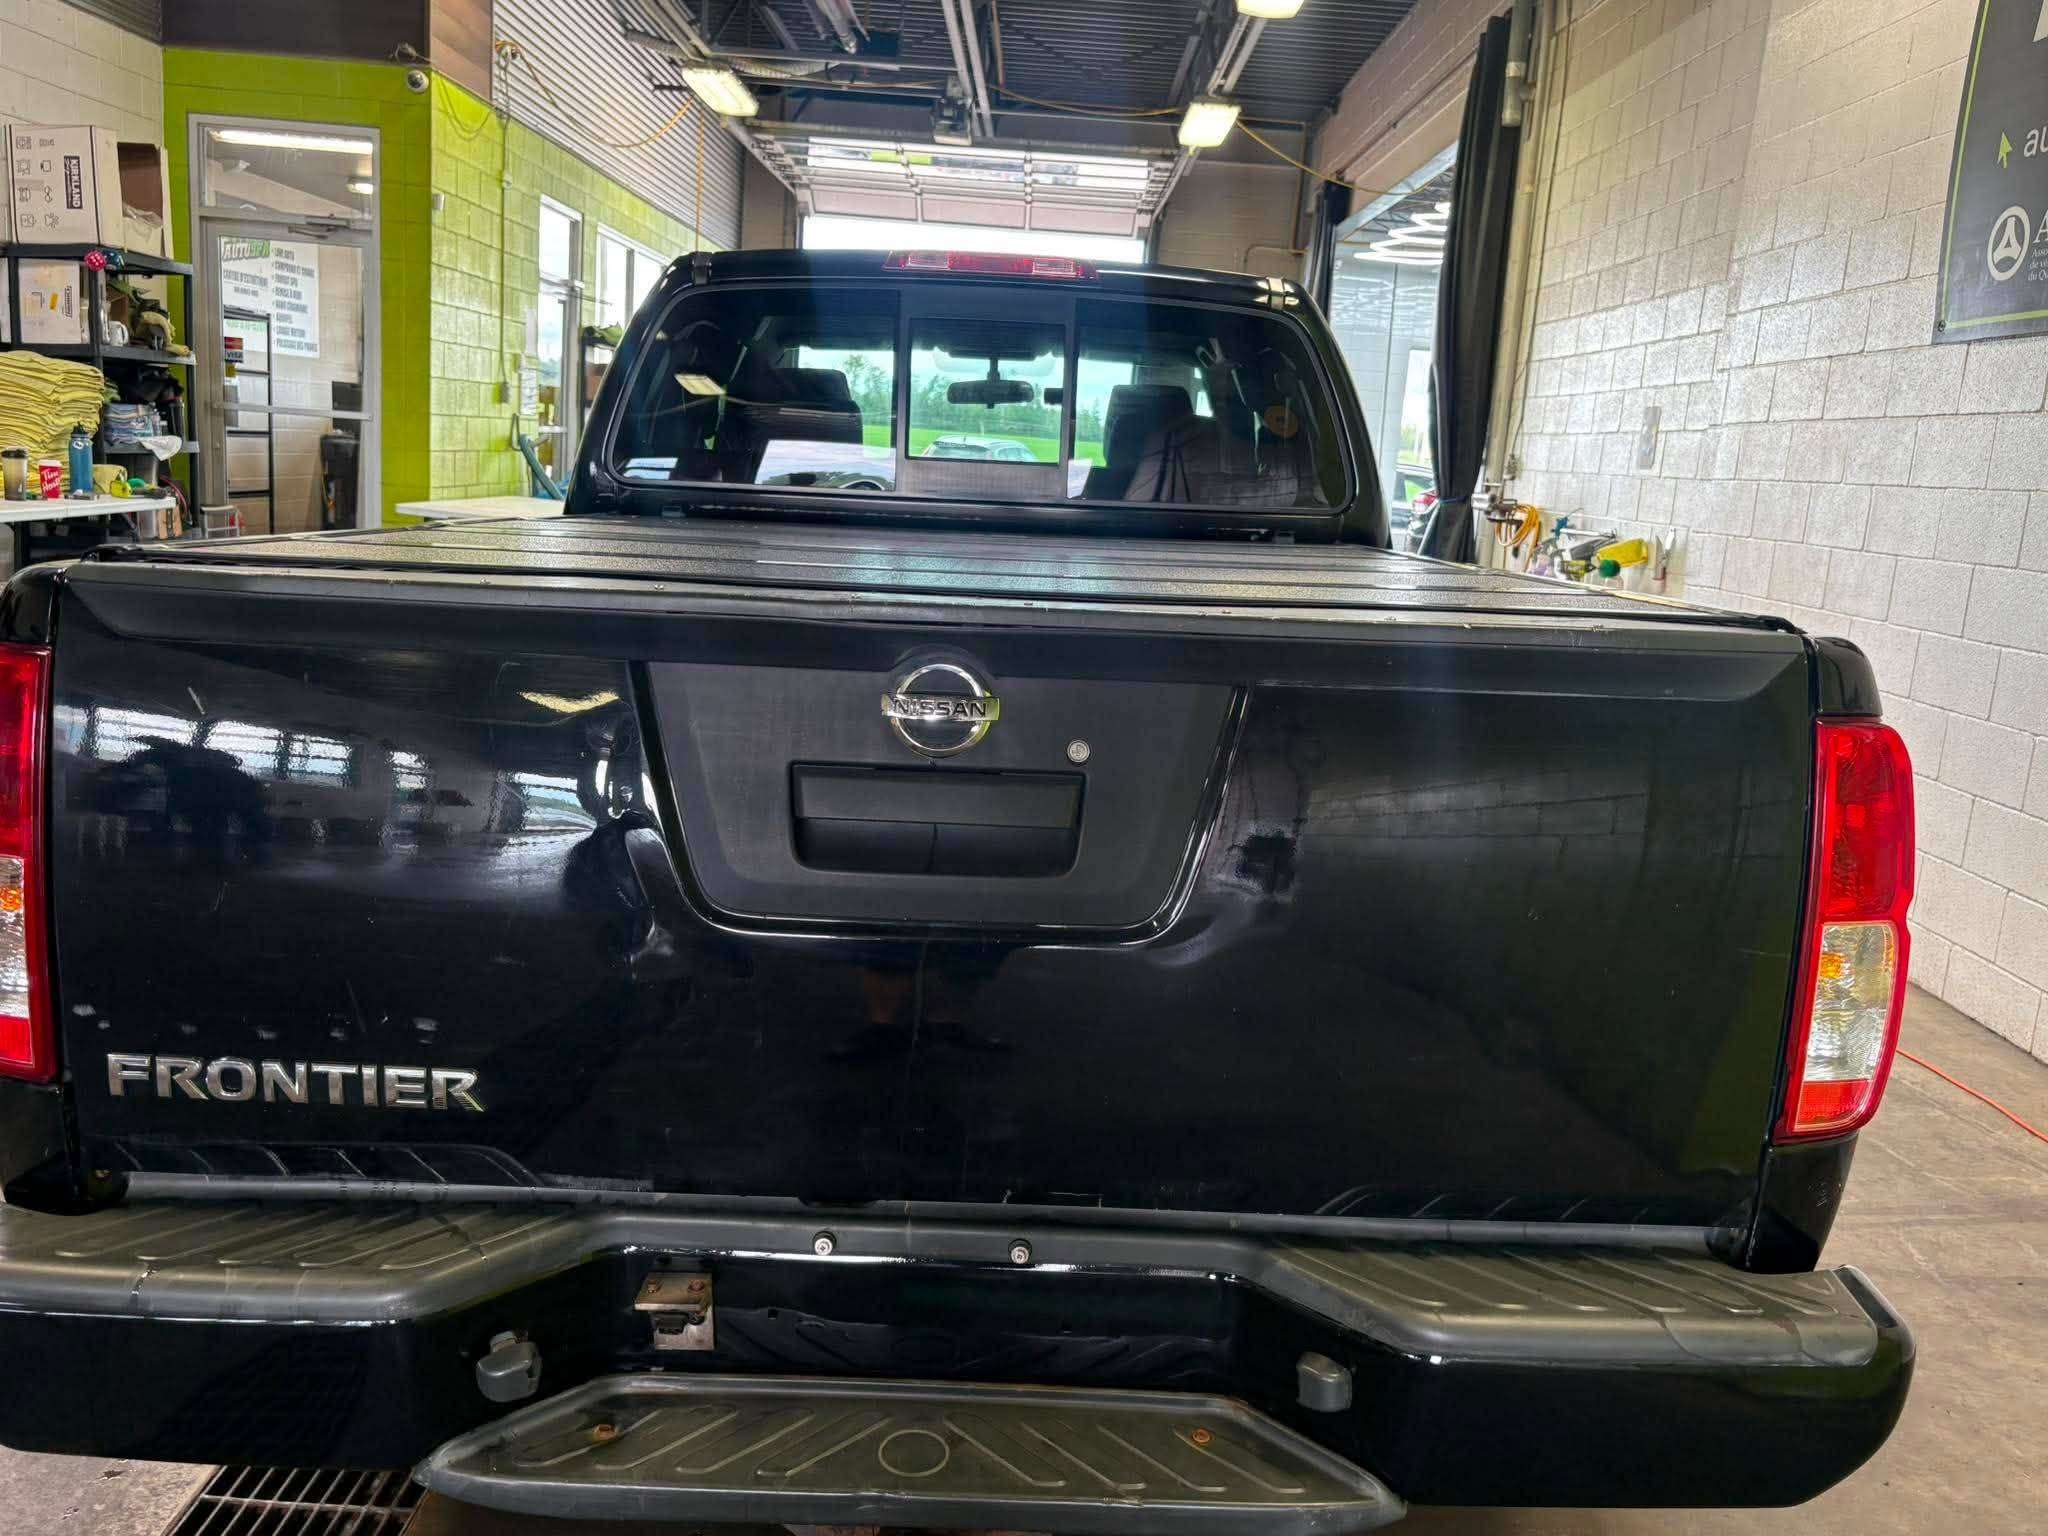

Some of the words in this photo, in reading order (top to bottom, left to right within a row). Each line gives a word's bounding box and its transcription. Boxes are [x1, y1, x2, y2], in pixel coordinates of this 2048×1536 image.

[70, 158, 81, 208] KIRKLAND
[894, 698, 987, 719] NISSAN
[107, 1053, 484, 1112] FRONTIER
